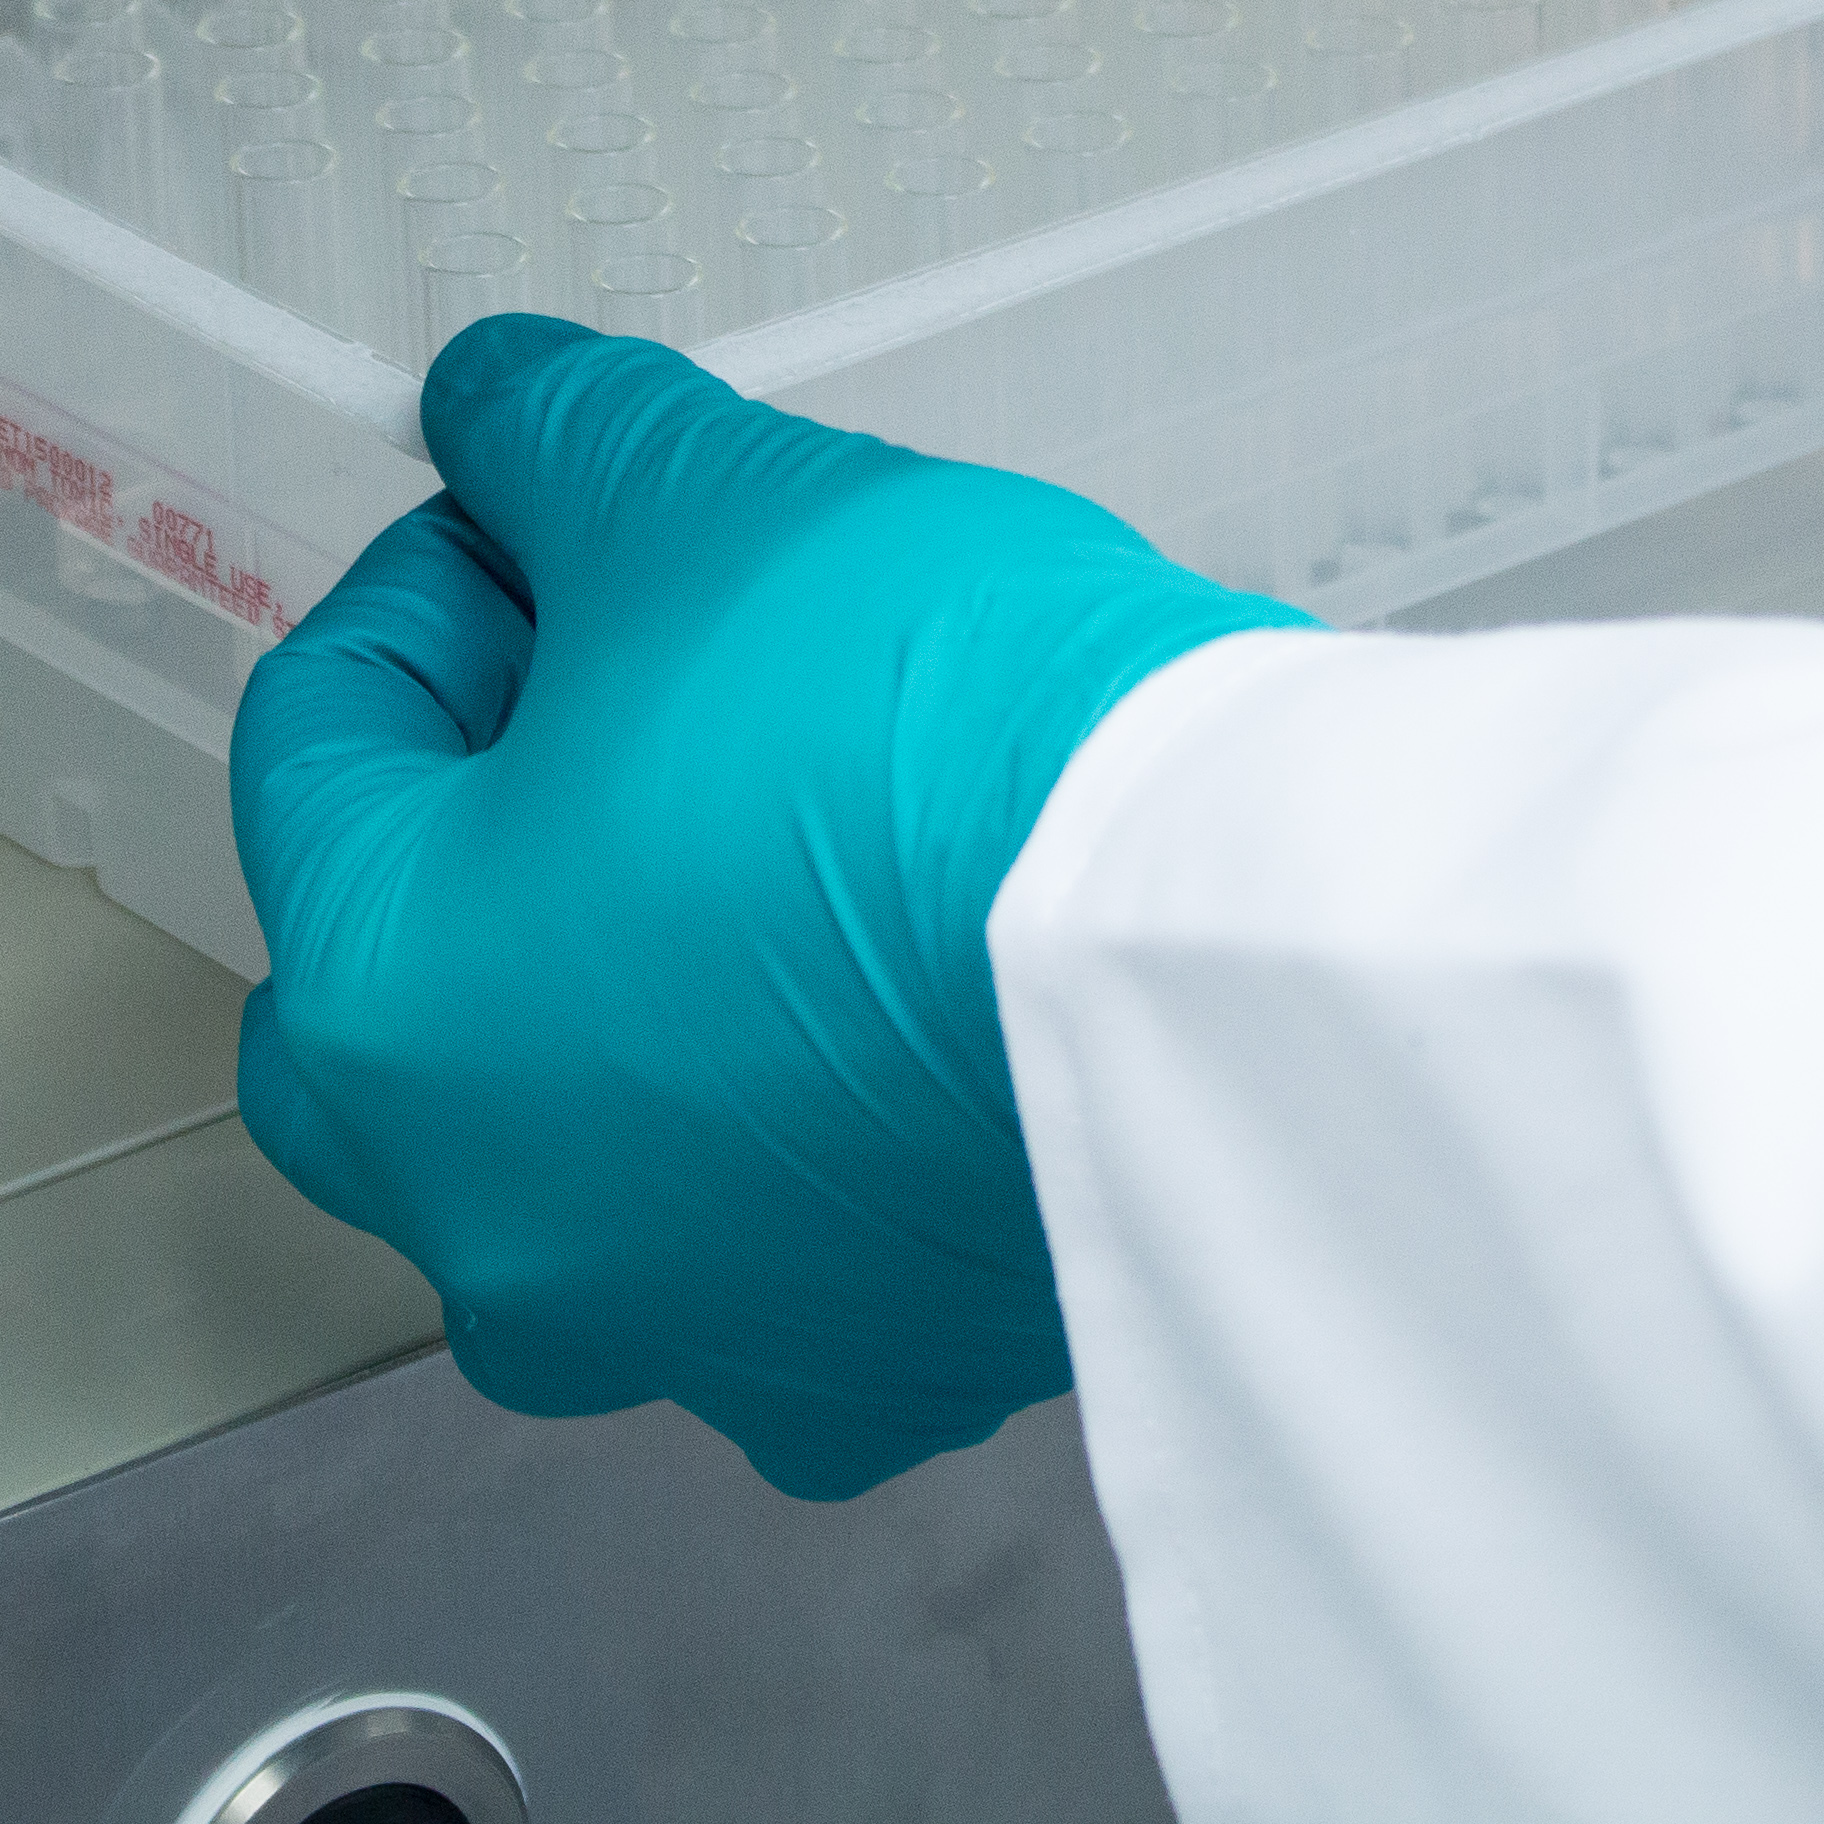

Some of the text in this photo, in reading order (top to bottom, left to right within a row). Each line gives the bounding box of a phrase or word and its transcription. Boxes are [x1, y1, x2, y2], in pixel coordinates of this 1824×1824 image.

[153, 501, 213, 552] 00771
[139, 517, 217, 580] SINGLE
[230, 566, 283, 611] USE,
